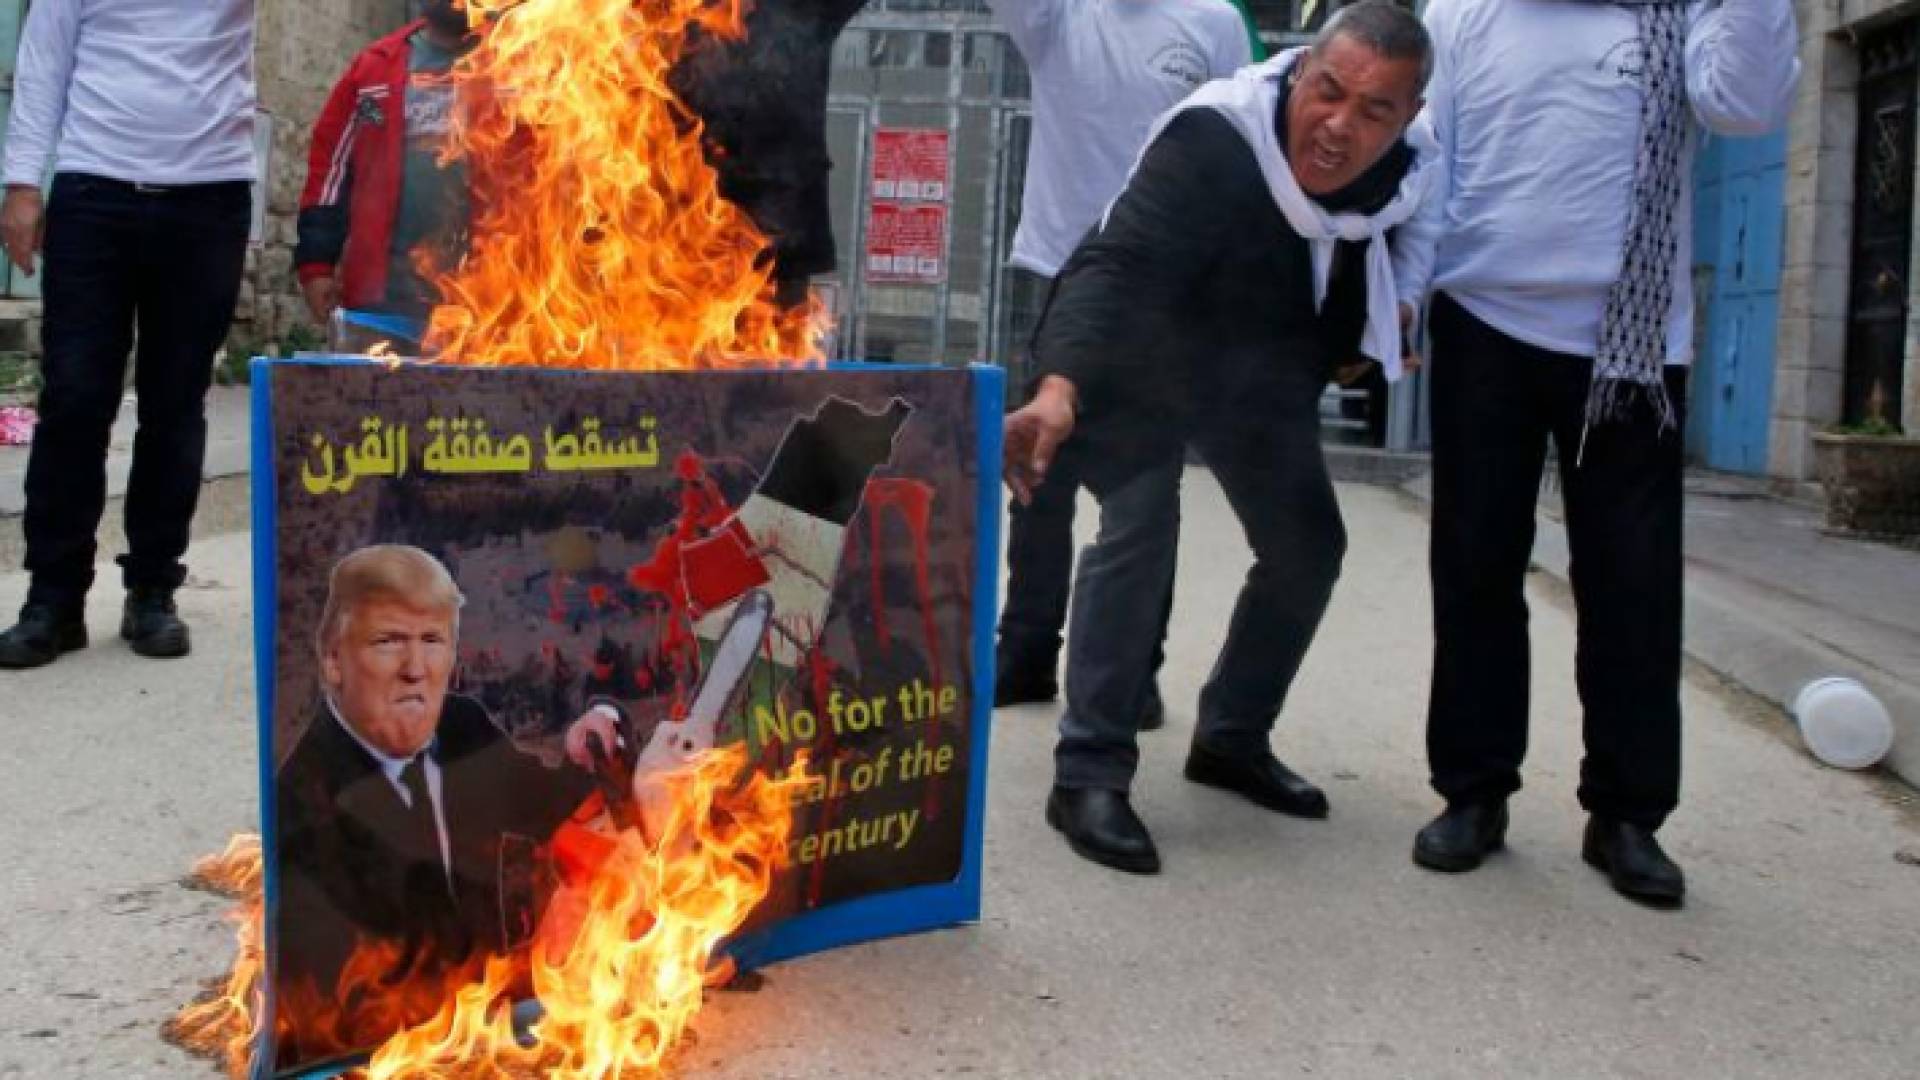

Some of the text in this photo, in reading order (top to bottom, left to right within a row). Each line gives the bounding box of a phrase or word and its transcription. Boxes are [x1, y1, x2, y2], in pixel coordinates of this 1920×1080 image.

[302, 415, 658, 495] تسقط صفقة القرن
[755, 679, 957, 746] No for the
[774, 739, 954, 807] al of the
